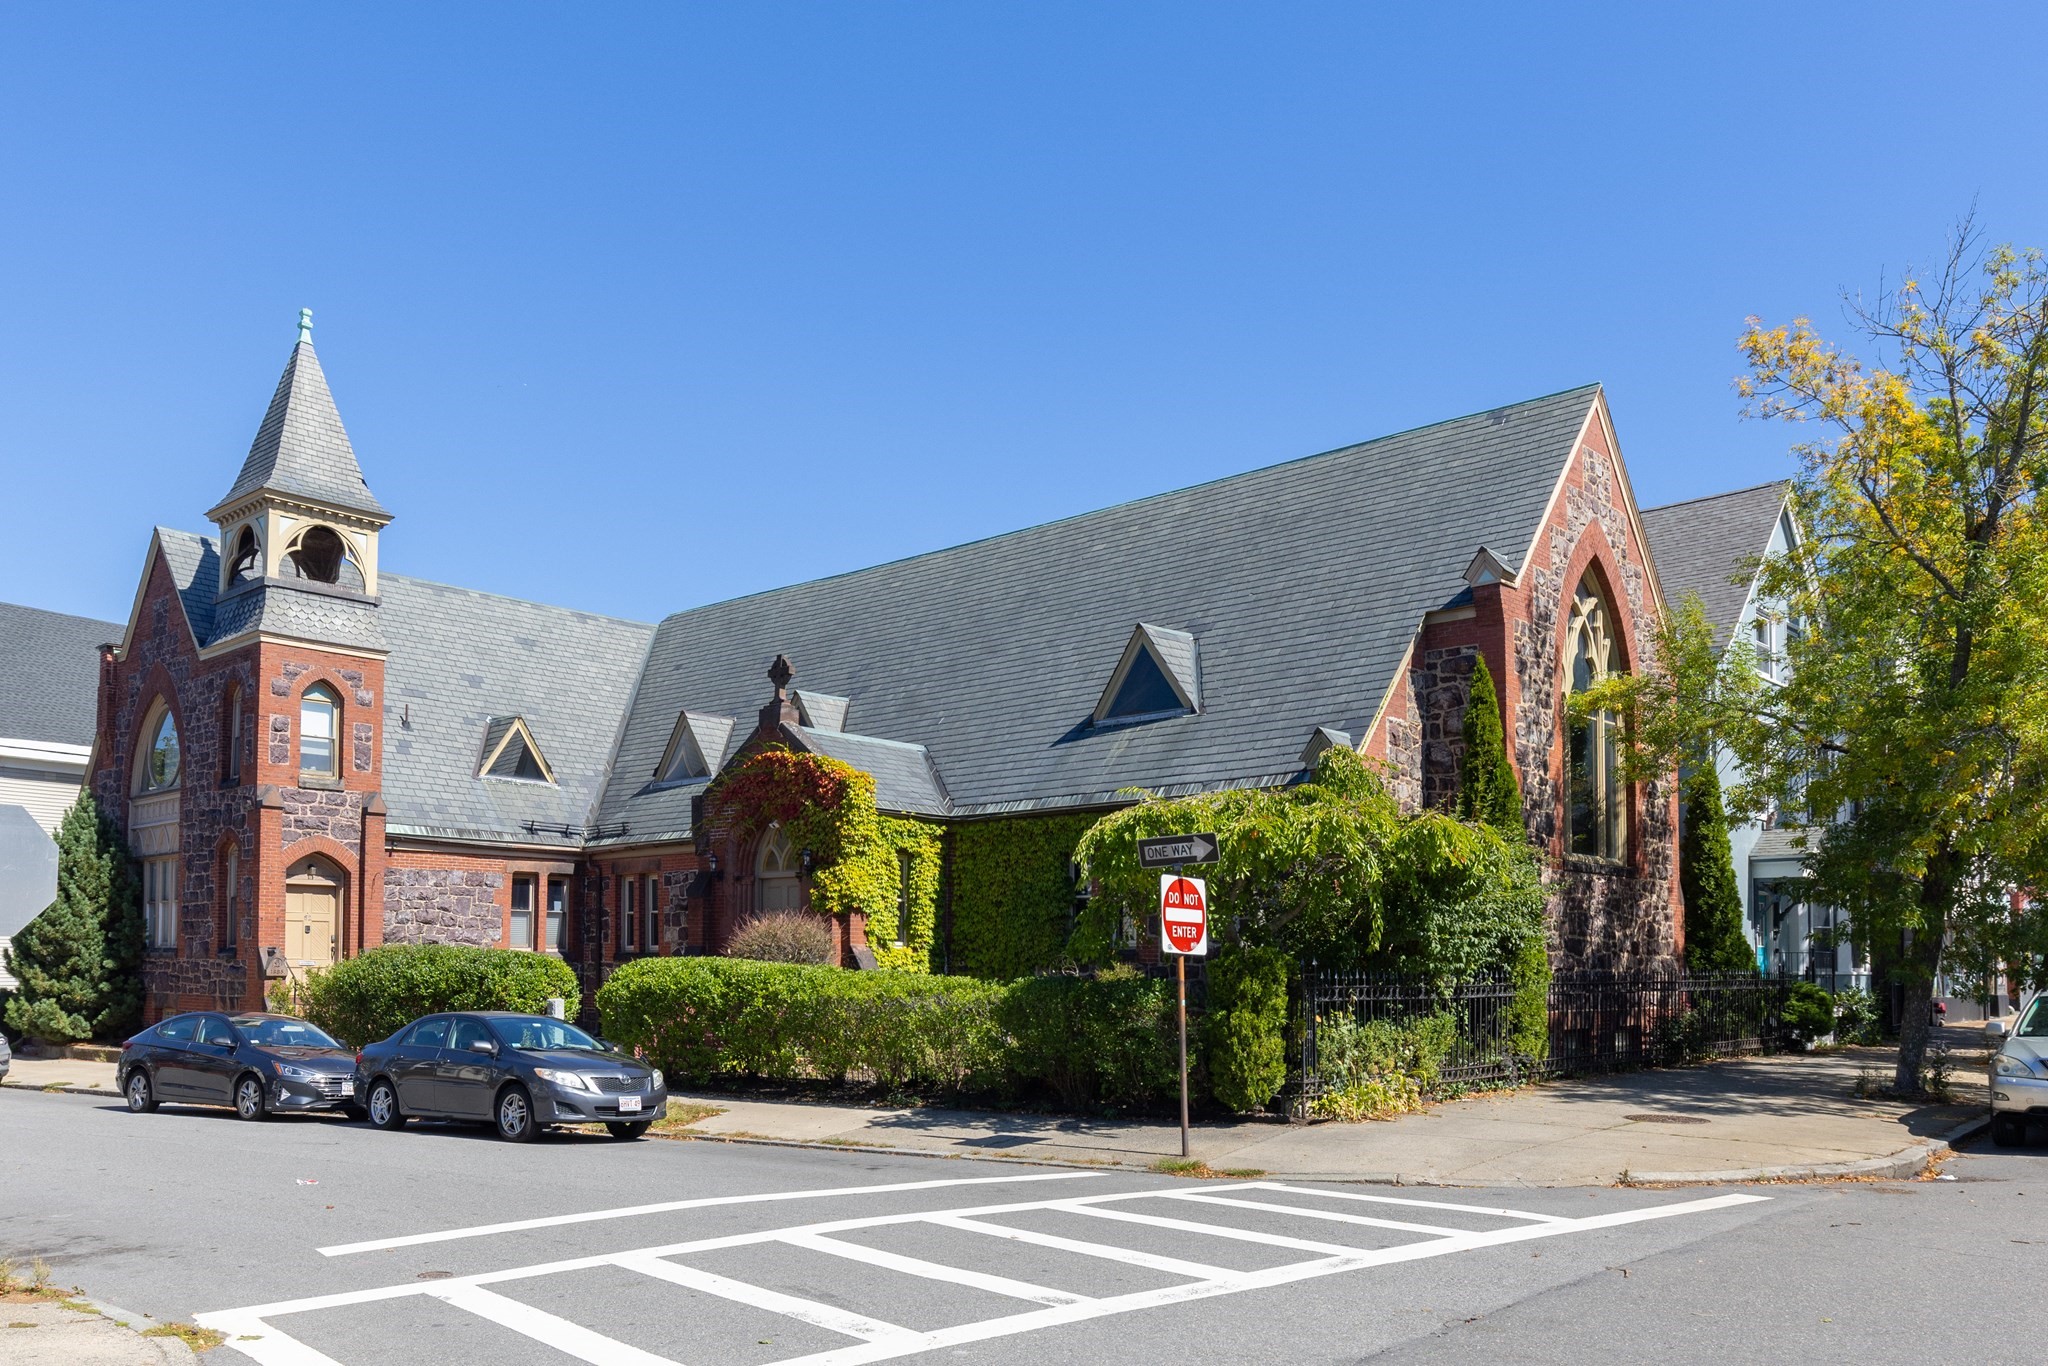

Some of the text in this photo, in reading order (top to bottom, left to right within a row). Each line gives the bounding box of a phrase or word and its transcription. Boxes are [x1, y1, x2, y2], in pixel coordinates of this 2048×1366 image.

[1147, 844, 1193, 858] ONE WAY
[1168, 892, 1198, 905] DO NOT
[1172, 925, 1197, 938] ENTER
